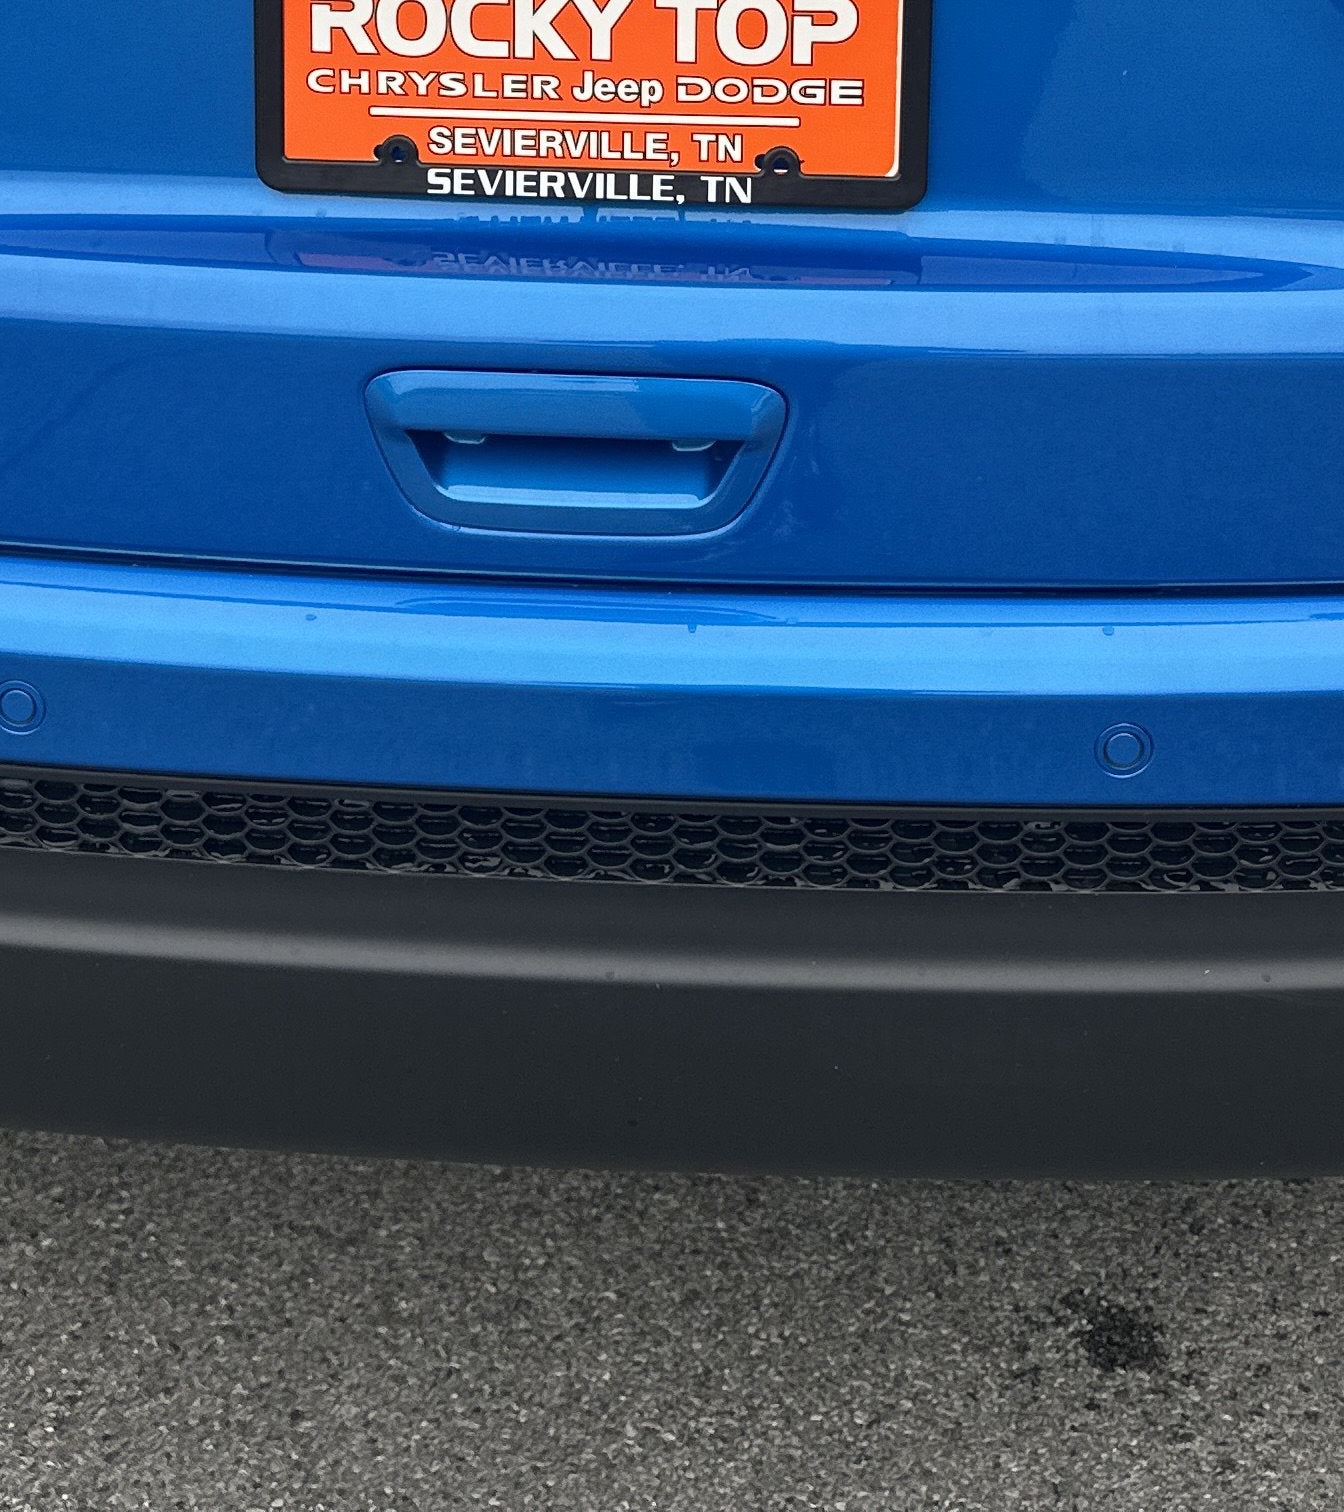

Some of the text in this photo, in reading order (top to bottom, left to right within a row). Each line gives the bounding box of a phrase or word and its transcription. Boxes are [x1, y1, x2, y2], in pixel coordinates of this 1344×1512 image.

[307, 66, 864, 108] CHRYSLER Jeep DODGE
[427, 125, 744, 167] SEVIERVILLE, TN
[426, 168, 753, 205] SEVIERVILLE, TN
